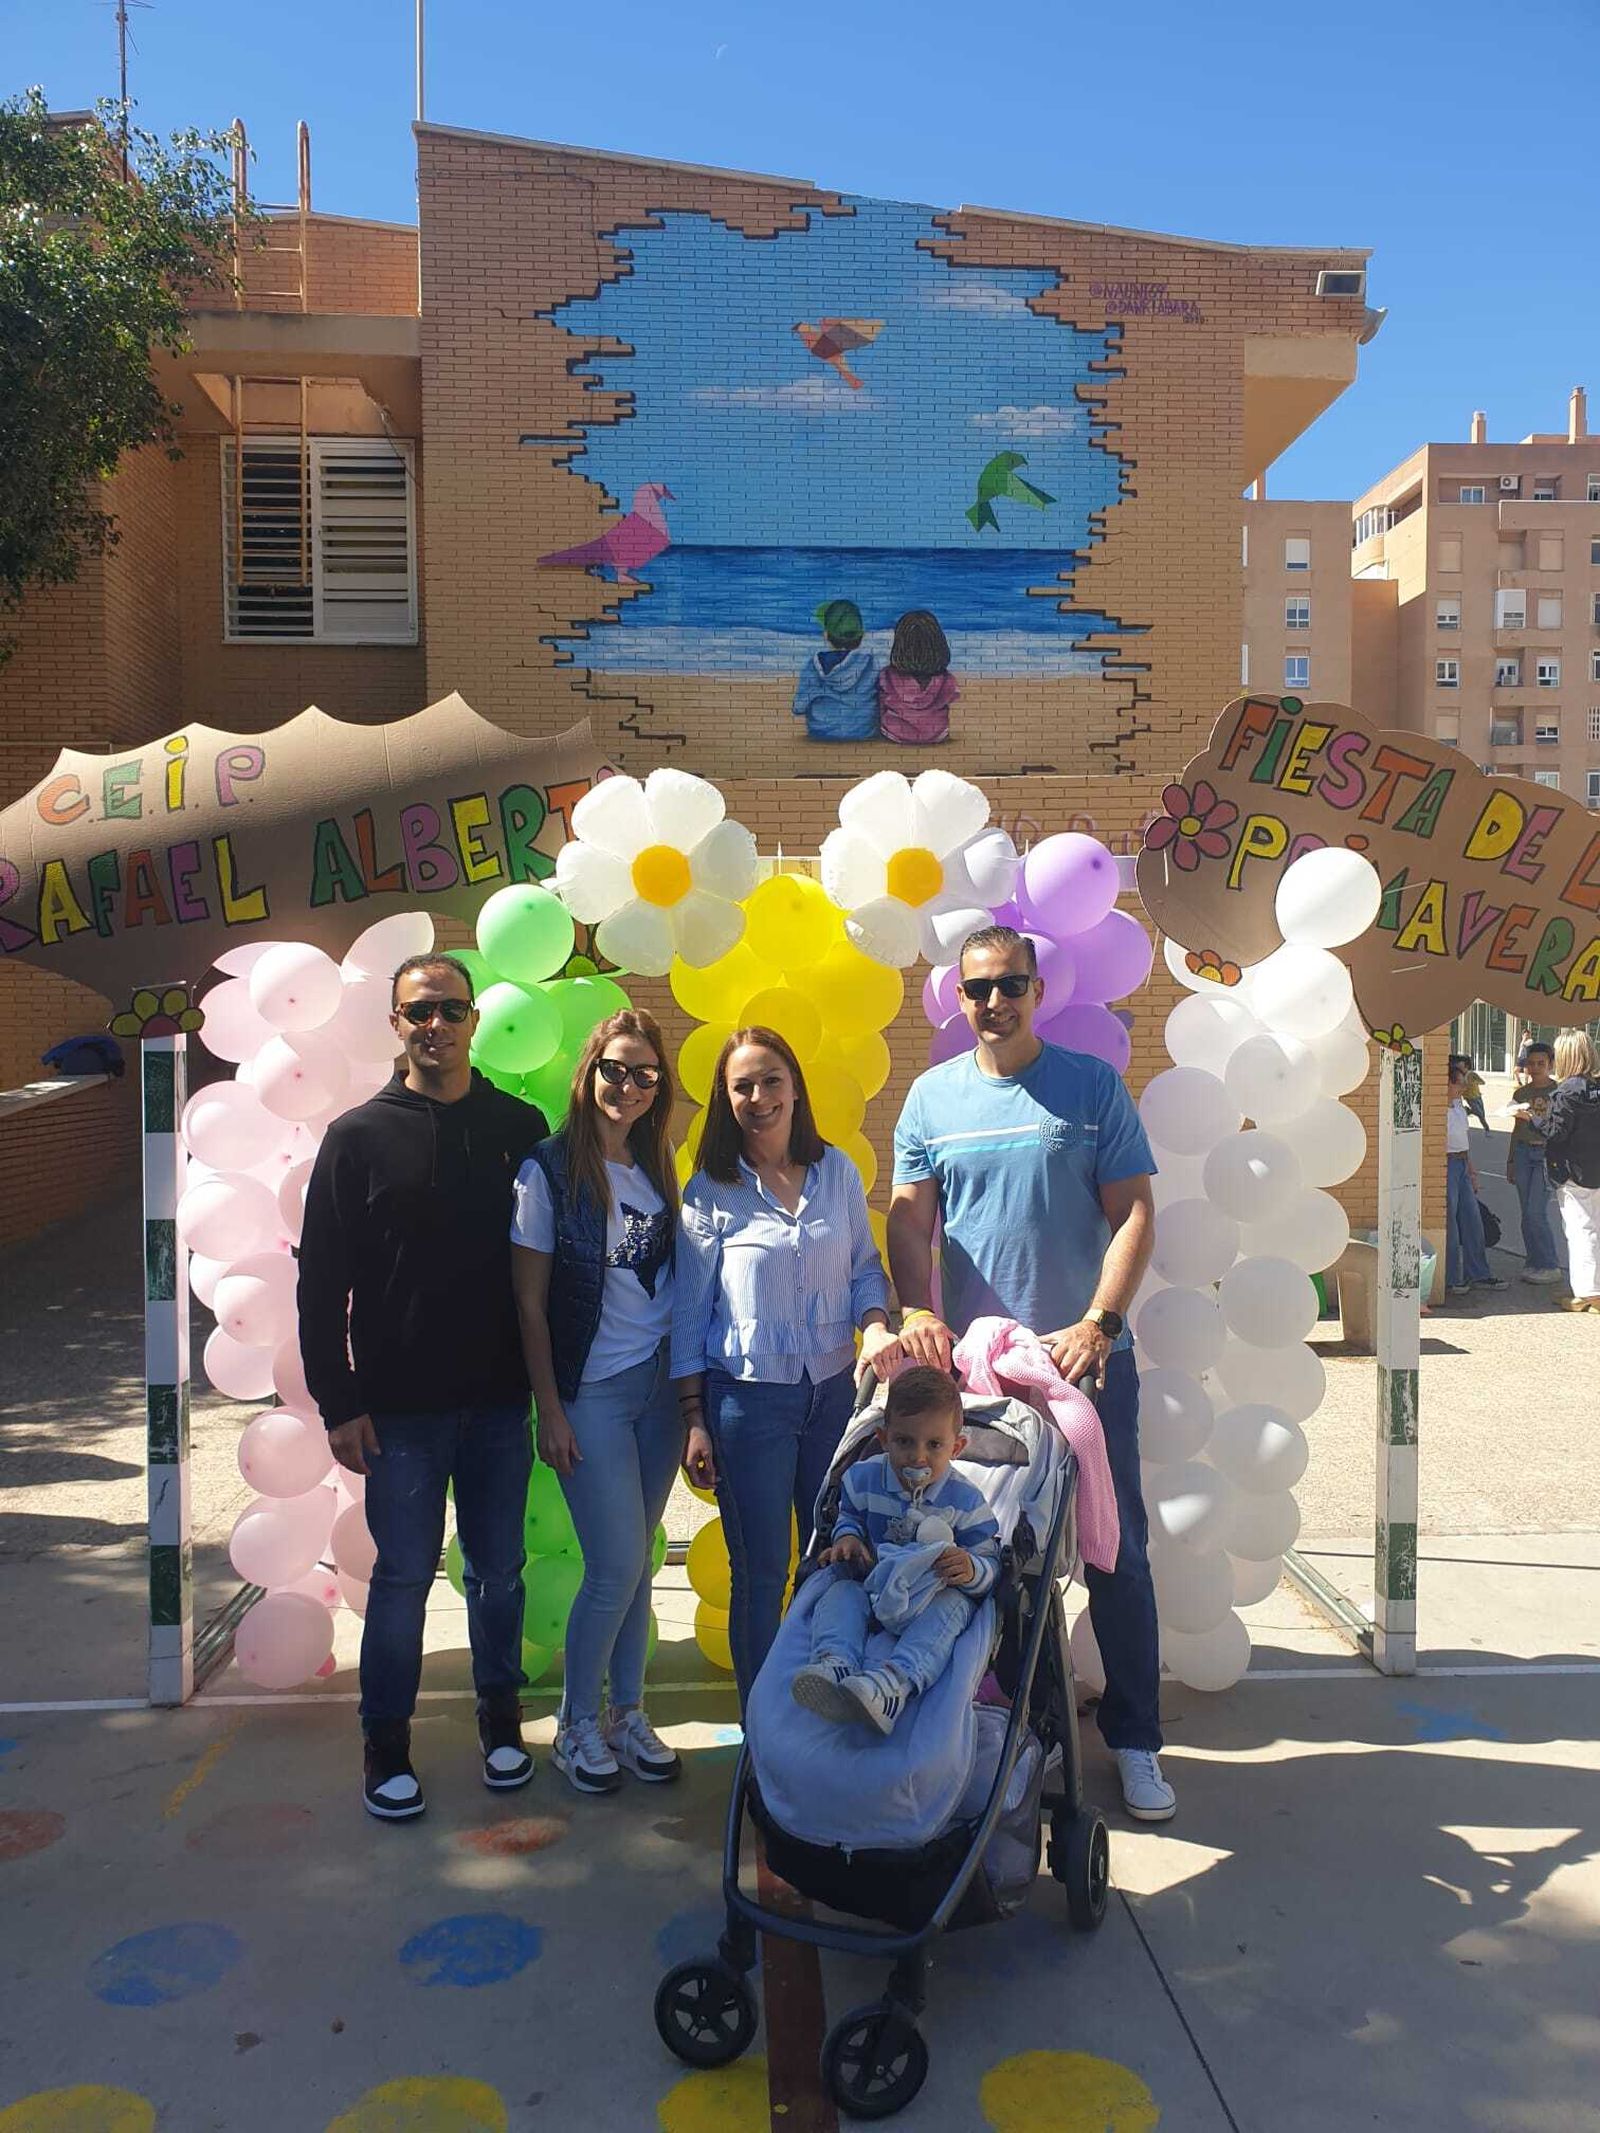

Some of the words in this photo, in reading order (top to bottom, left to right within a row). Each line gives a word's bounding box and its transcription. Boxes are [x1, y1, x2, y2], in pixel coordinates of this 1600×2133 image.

[0, 834, 271, 954] RAFAEL
[310, 766, 616, 909] ALBERT
[1463, 788, 1564, 885] DE
[1557, 830, 1600, 914] L
